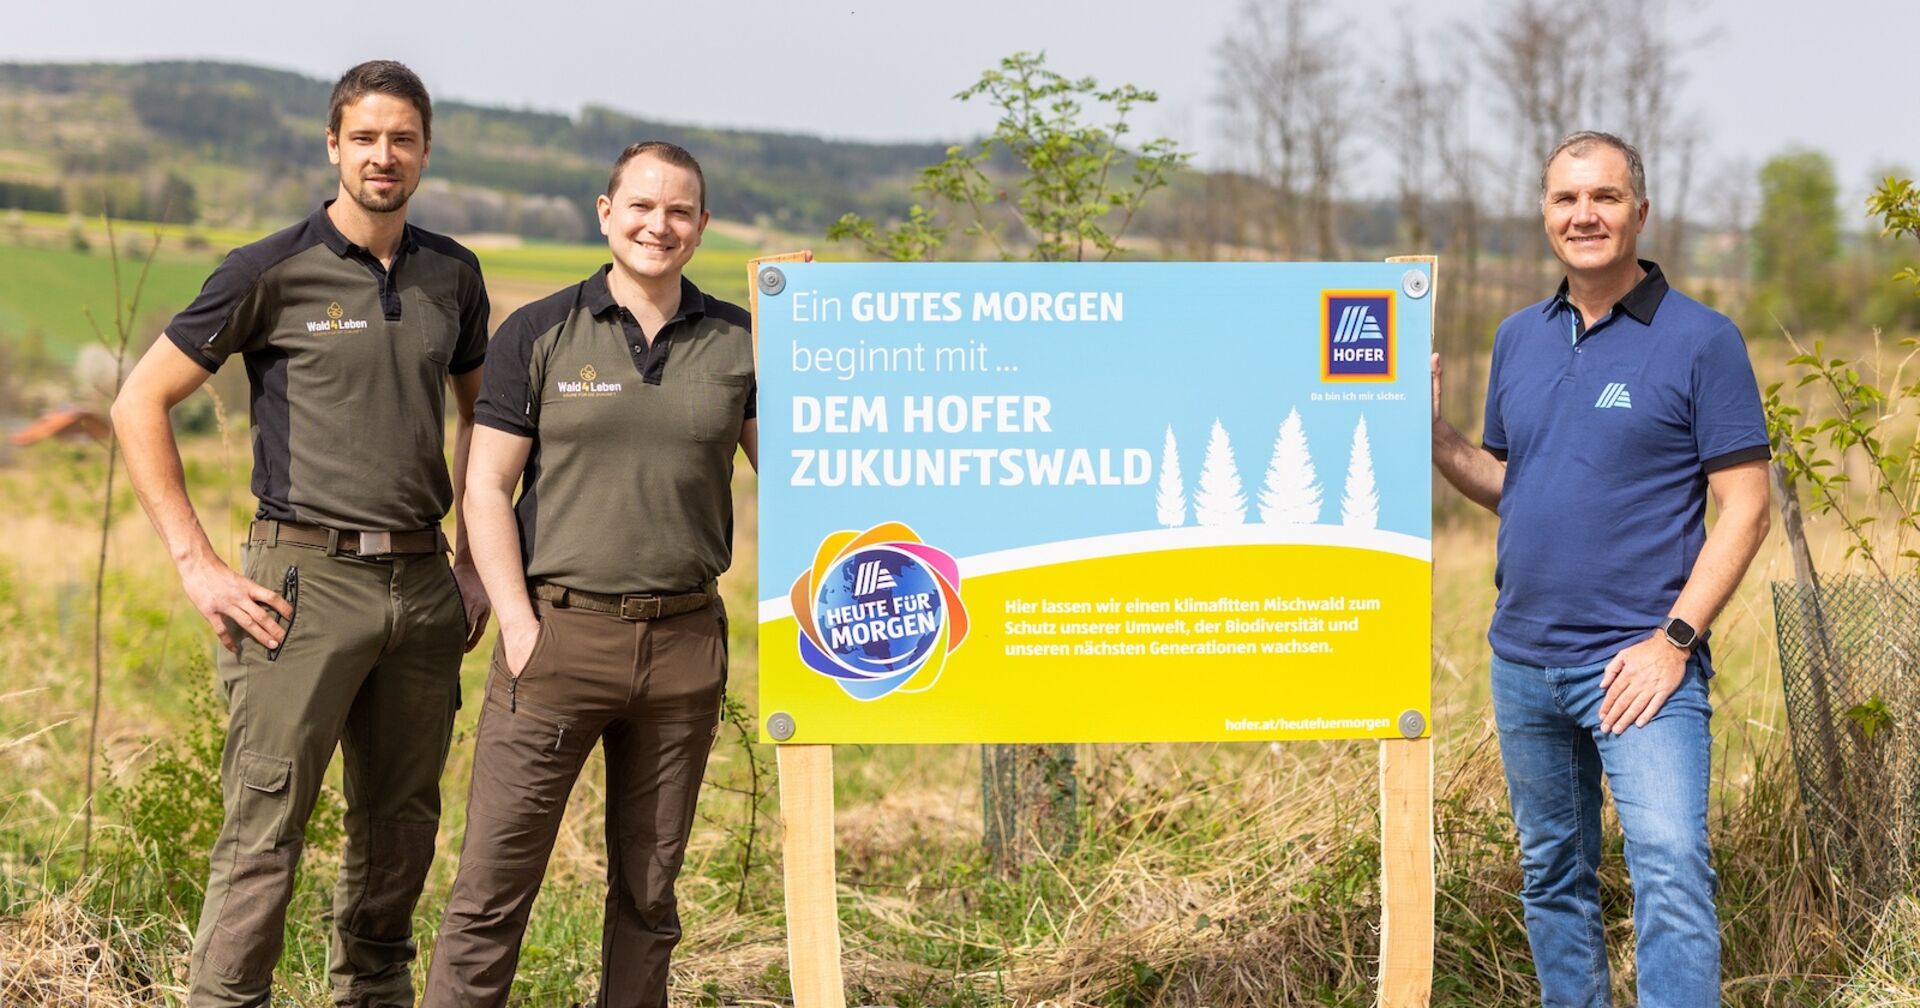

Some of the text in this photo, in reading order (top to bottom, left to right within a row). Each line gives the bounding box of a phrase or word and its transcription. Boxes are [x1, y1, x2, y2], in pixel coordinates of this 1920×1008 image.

[792, 290, 1124, 322] Ein GUTES MORGEN
[792, 340, 926, 381] beginnt
[935, 340, 988, 372] mit
[1333, 348, 1385, 362] HOFER
[1311, 392, 1407, 401] Da bin ich mir sicher.
[792, 395, 1053, 433] DEM HOFER
[790, 448, 1152, 487] ZUKUNFTSWALD
[826, 599, 889, 626] HEUTE
[1004, 596, 1381, 614] Hier lassen wir einen klimafitten Mischwald zum
[831, 611, 936, 649] MORGEN
[1004, 617, 1359, 636] Schutz unserer Umwelt, der Biodiversität und
[1004, 639, 1334, 656] unseren nächsten Generationen wachsen.
[1225, 717, 1390, 731] hofer.at/heutefuermorgen
